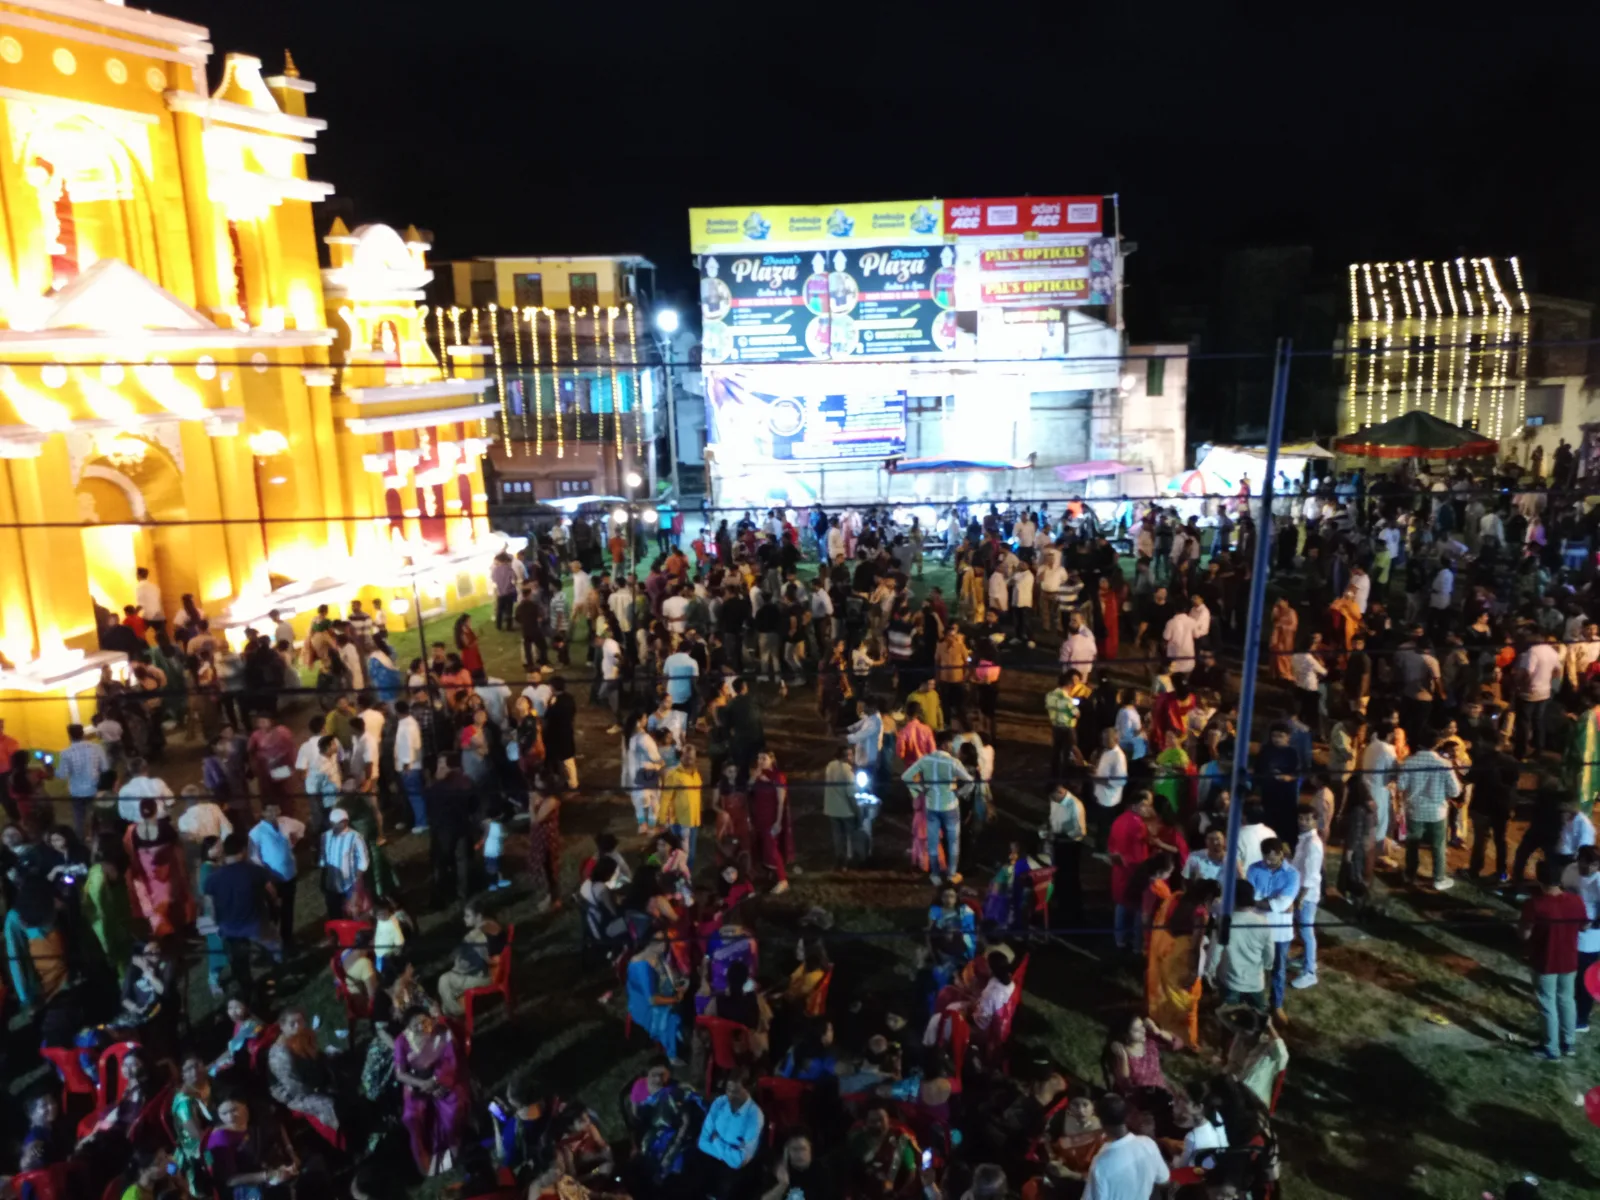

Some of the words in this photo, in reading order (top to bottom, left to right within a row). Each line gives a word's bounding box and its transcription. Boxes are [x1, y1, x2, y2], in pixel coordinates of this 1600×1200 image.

[951, 205, 981, 217] adani
[1031, 203, 1061, 215] adani
[951, 217, 980, 229] ACC
[1031, 215, 1061, 227] ACC
[985, 249, 1020, 262] PAL'S
[1022, 246, 1085, 260] OPTICALS
[731, 258, 798, 288] Plaza
[859, 252, 926, 283] Plaza
[985, 281, 1020, 295] PAL'S
[1022, 278, 1085, 293] OPTICALS
